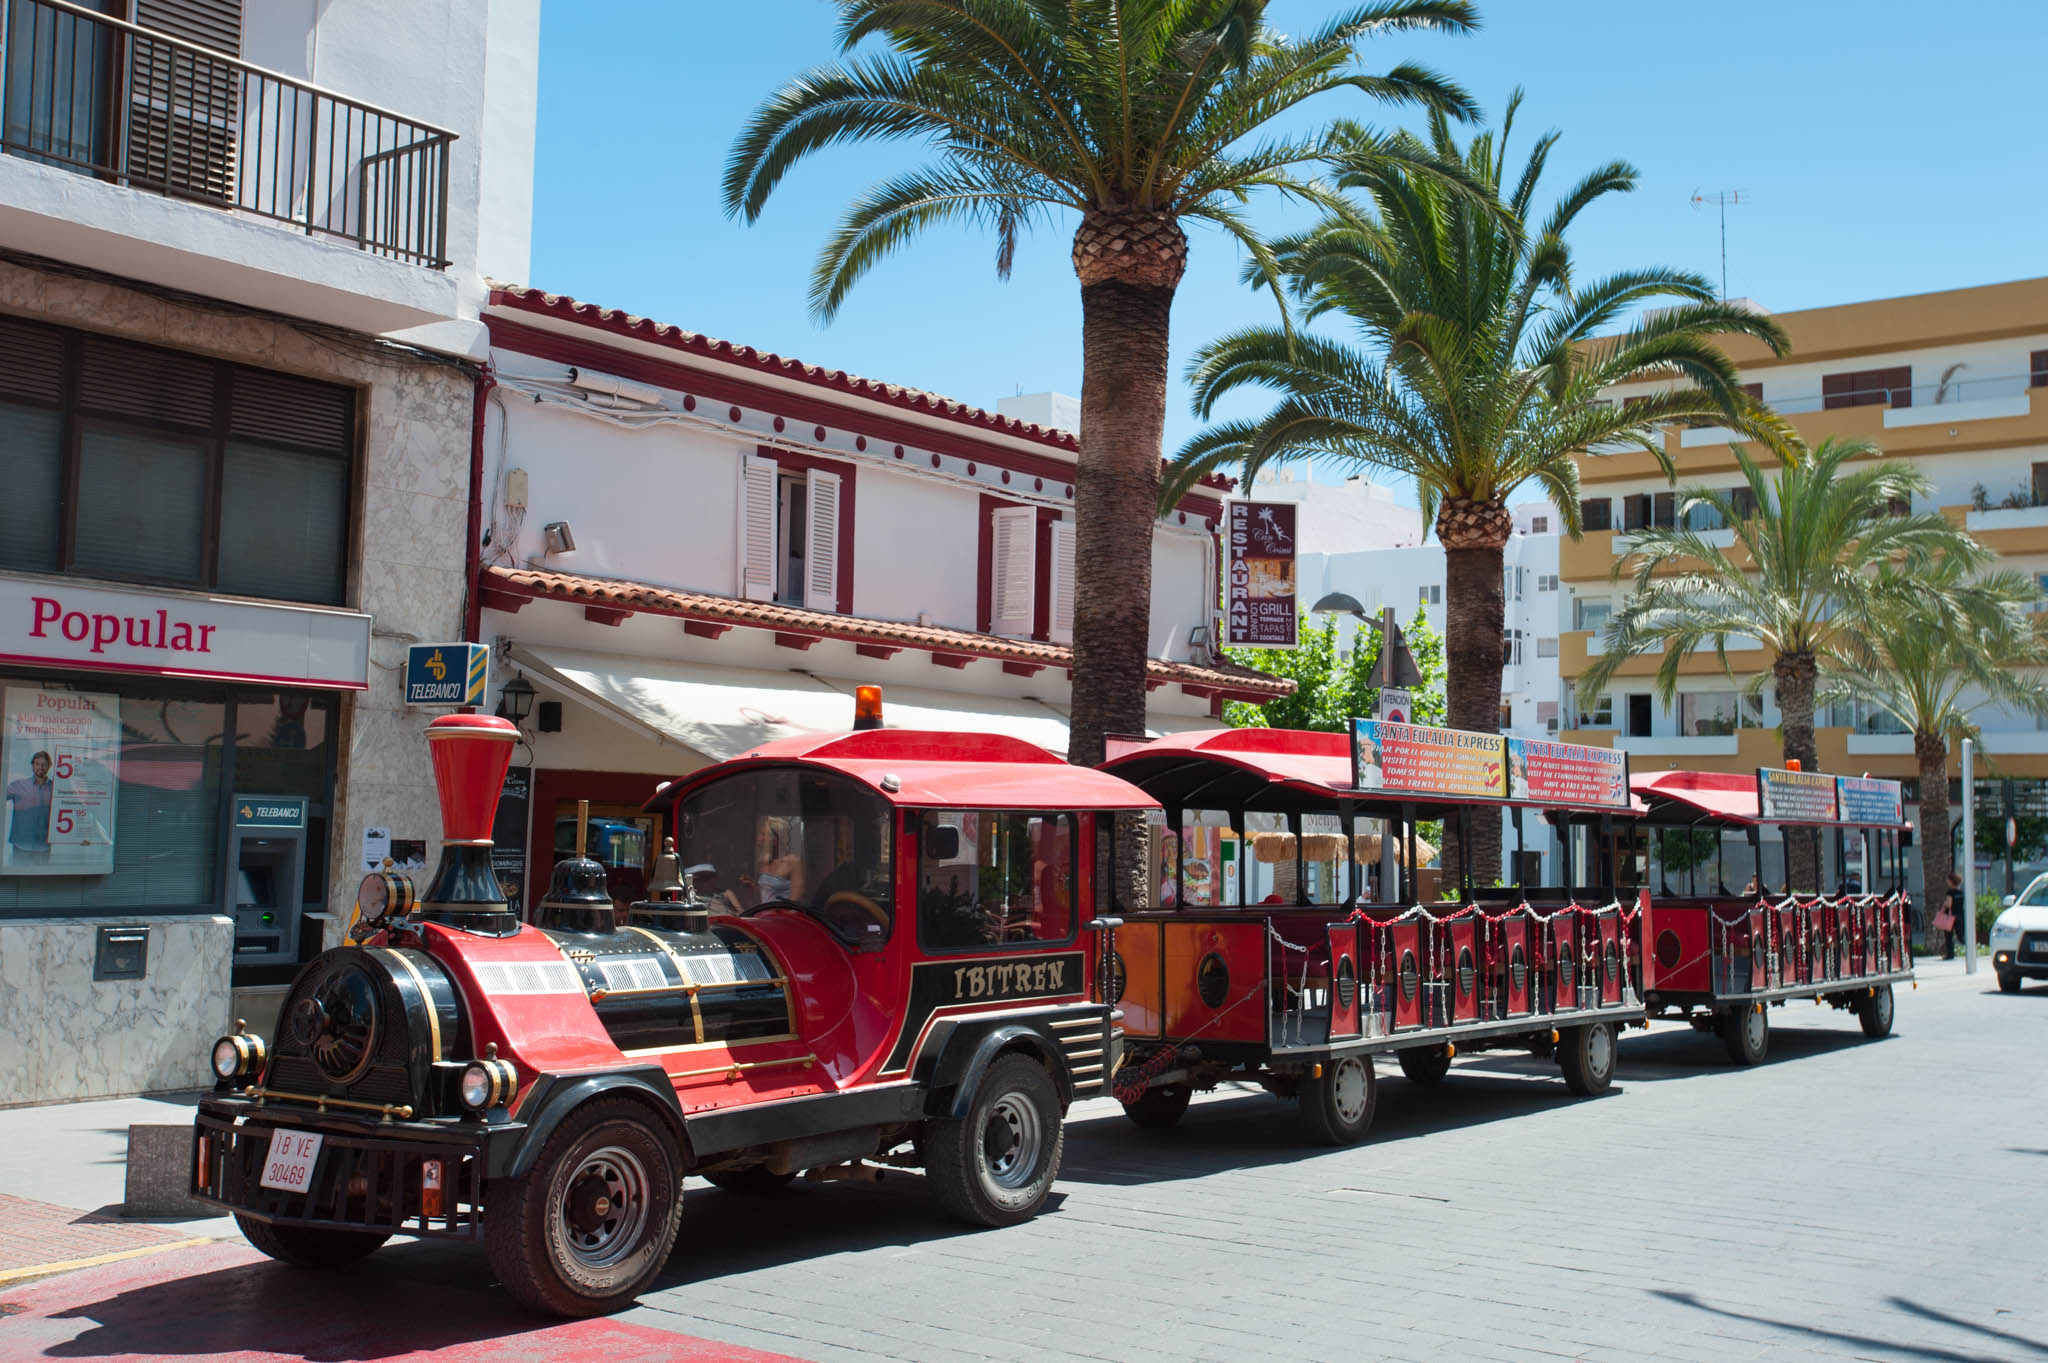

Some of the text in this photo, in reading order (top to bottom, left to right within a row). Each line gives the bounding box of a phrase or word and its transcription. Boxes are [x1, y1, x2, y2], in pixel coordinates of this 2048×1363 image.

[1231, 504, 1249, 640] RESTAURANT
[1259, 602, 1293, 615] GRILL
[28, 596, 216, 653] Popular
[1259, 624, 1285, 633] TAPAS
[411, 683, 461, 699] TELEBANCO
[36, 693, 97, 712] Popular
[1373, 724, 1501, 752] SANTA EULALIA EXPRESS
[1382, 756, 1408, 766] VISITE
[1409, 758, 1417, 766] EL
[1419, 760, 1446, 769] MUSEO
[1521, 741, 1623, 765] SANTA EULALIA EXPRESS
[55, 754, 73, 779] 5
[1418, 770, 1434, 778] UNA
[55, 809, 74, 834] 5
[256, 807, 300, 818] TELEBANCO
[954, 960, 1064, 998] IBITREN
[296, 1136, 314, 1158] VE
[268, 1163, 304, 1184] 30469
